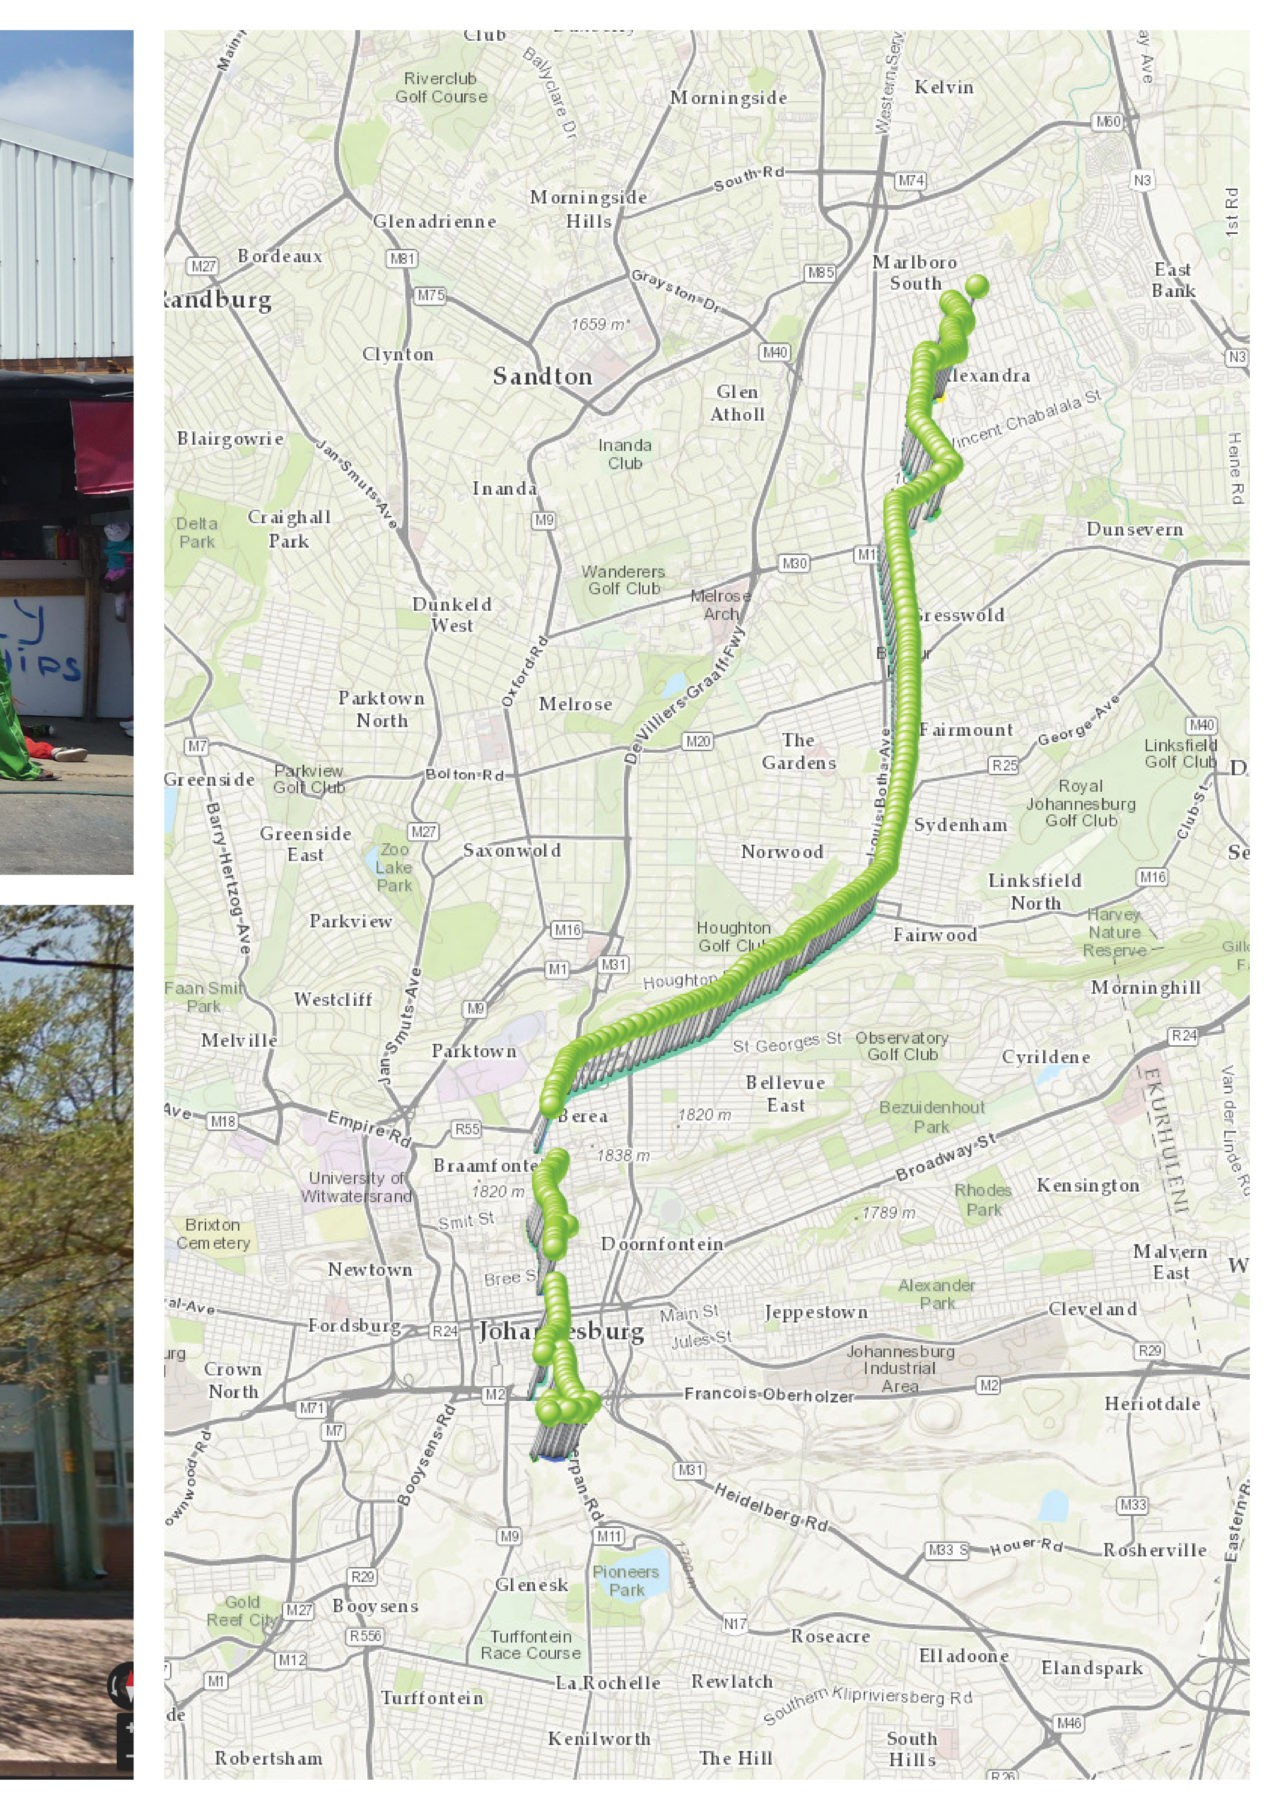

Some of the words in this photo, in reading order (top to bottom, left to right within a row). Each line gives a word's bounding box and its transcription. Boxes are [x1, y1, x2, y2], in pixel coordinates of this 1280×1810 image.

[464, 30, 505, 41] Club
[405, 72, 476, 84] Riverclub
[916, 80, 973, 93] Kelvin
[671, 90, 787, 108] Morningside
[1098, 116, 1120, 127] M60
[713, 171, 758, 193] South
[763, 167, 784, 180] Rd
[900, 175, 923, 185] M74
[1135, 175, 1151, 185] N3
[531, 190, 646, 208] Morningside
[374, 214, 496, 228] Glenadrienne
[568, 214, 611, 228] Hills
[239, 246, 321, 262] Bordeaux
[391, 253, 413, 264] M81
[193, 261, 215, 272] M27
[873, 255, 956, 269] Marlboro
[1156, 261, 1190, 276] East
[809, 267, 834, 278] M85
[891, 276, 941, 290] South
[419, 290, 444, 300] M75
[1153, 284, 1195, 297] Bank
[363, 347, 433, 360] Clynton
[764, 347, 787, 357] M40
[494, 367, 592, 385] Sandton
[717, 385, 757, 398] Glen
[711, 407, 764, 421] Atholl
[178, 431, 283, 449] Blairgowrie
[474, 481, 536, 495] Inanda
[248, 510, 330, 528] Craighall
[536, 515, 553, 525] M9
[1088, 522, 1182, 536] Dunsevern
[270, 534, 309, 548] Park
[784, 558, 806, 568] M30
[583, 566, 665, 578] Wanderers
[414, 597, 491, 611] Dunkeld
[432, 618, 472, 632] West
[340, 691, 424, 705] Parktown
[540, 697, 612, 710] Melrose
[357, 713, 407, 727] North
[920, 722, 1013, 738] Fairmount
[189, 741, 206, 751] M7
[687, 736, 710, 746] M20
[783, 733, 814, 746] The
[1146, 738, 1217, 752] Linksfield
[763, 755, 836, 769] Gardens
[992, 759, 1017, 772] R25
[164, 772, 254, 786] Greenside
[915, 818, 1007, 831] Sydenham
[261, 826, 351, 840] Greenside
[413, 826, 435, 837] M27
[288, 848, 322, 861] East
[464, 843, 560, 857] Saxonwold
[742, 845, 823, 858] Norwood
[990, 873, 1081, 887] Linksfield
[1141, 872, 1165, 882] M16
[1012, 896, 1060, 910] North
[311, 914, 392, 927] Parkview
[556, 924, 580, 935] M16
[894, 927, 976, 941] Fairwood
[603, 959, 624, 970] M31
[1093, 980, 1200, 998] Morninghill
[295, 992, 371, 1006] Westcliff
[202, 1033, 277, 1047] Melville
[433, 1044, 516, 1057] Parktown
[1003, 1050, 1090, 1063] Cyrildene
[747, 1075, 824, 1089] Bellevue
[768, 1098, 804, 1112] East
[880, 1101, 984, 1113] Bezuidenhout
[212, 1116, 235, 1127] M18
[558, 1109, 608, 1125] Berea
[328, 1110, 385, 1137] Empire
[388, 1130, 412, 1148] Rd
[456, 1124, 479, 1134] R55
[1144, 1067, 1190, 1215] EKURHULENI
[895, 1143, 976, 1182] Broadway
[978, 1132, 998, 1149] St
[1038, 1178, 1139, 1196] Kensington
[186, 1219, 239, 1231] Brixton
[177, 1237, 250, 1252] Cemetery
[602, 1237, 722, 1250] Doornfontein
[1134, 1244, 1207, 1260] Malvern
[329, 1262, 411, 1276] Newtown
[1154, 1265, 1189, 1279] East
[899, 1279, 975, 1291] Alexander
[766, 1305, 867, 1323] Jeppestown
[1049, 1302, 1136, 1315] Cleveland
[310, 1318, 401, 1336] Fordsburg
[434, 1326, 457, 1336] R24
[478, 1321, 644, 1344] Johaesburg
[847, 1345, 954, 1360] Johannesburg
[1140, 1345, 1161, 1356] R29
[205, 1362, 261, 1376] Crown
[210, 1385, 258, 1398] North
[981, 1380, 998, 1390] M2
[487, 1389, 505, 1400] M2
[686, 1387, 756, 1400] Francois
[764, 1388, 854, 1402] Oberholzer
[301, 1402, 322, 1413] M71
[1106, 1396, 1200, 1410] Heriotdale
[325, 1425, 342, 1438] M7
[680, 1462, 704, 1475] M31
[713, 1482, 801, 1526] Heidelberg
[805, 1515, 829, 1532] Rd
[1122, 1499, 1146, 1510] M33
[502, 1531, 519, 1541] M9
[598, 1531, 620, 1541] M11
[930, 1544, 953, 1555] M33
[960, 1544, 968, 1556] S
[1104, 1543, 1206, 1556] Rosherville
[352, 1571, 374, 1582] R29
[496, 1578, 568, 1591] Glenesk
[333, 1599, 418, 1612] Booysens
[725, 1618, 747, 1629] N17
[351, 1631, 381, 1641] R556
[491, 1630, 571, 1643] Turffontein
[792, 1629, 870, 1643] Roseacre
[920, 1648, 1008, 1662] Elladoone
[1042, 1660, 1143, 1679] Elandspark
[208, 1674, 225, 1687] M1
[557, 1676, 576, 1689] La
[584, 1676, 660, 1689] Rochelle
[693, 1674, 772, 1688] Rewlatch
[381, 1691, 482, 1704] Turffontein
[1058, 1718, 1081, 1728] M46
[549, 1732, 650, 1745] Kenilworth
[888, 1732, 937, 1745] South
[216, 1751, 322, 1765] Robertsham
[700, 1751, 731, 1765] The
[739, 1751, 771, 1765] Hill
[890, 1753, 935, 1766] Hills
